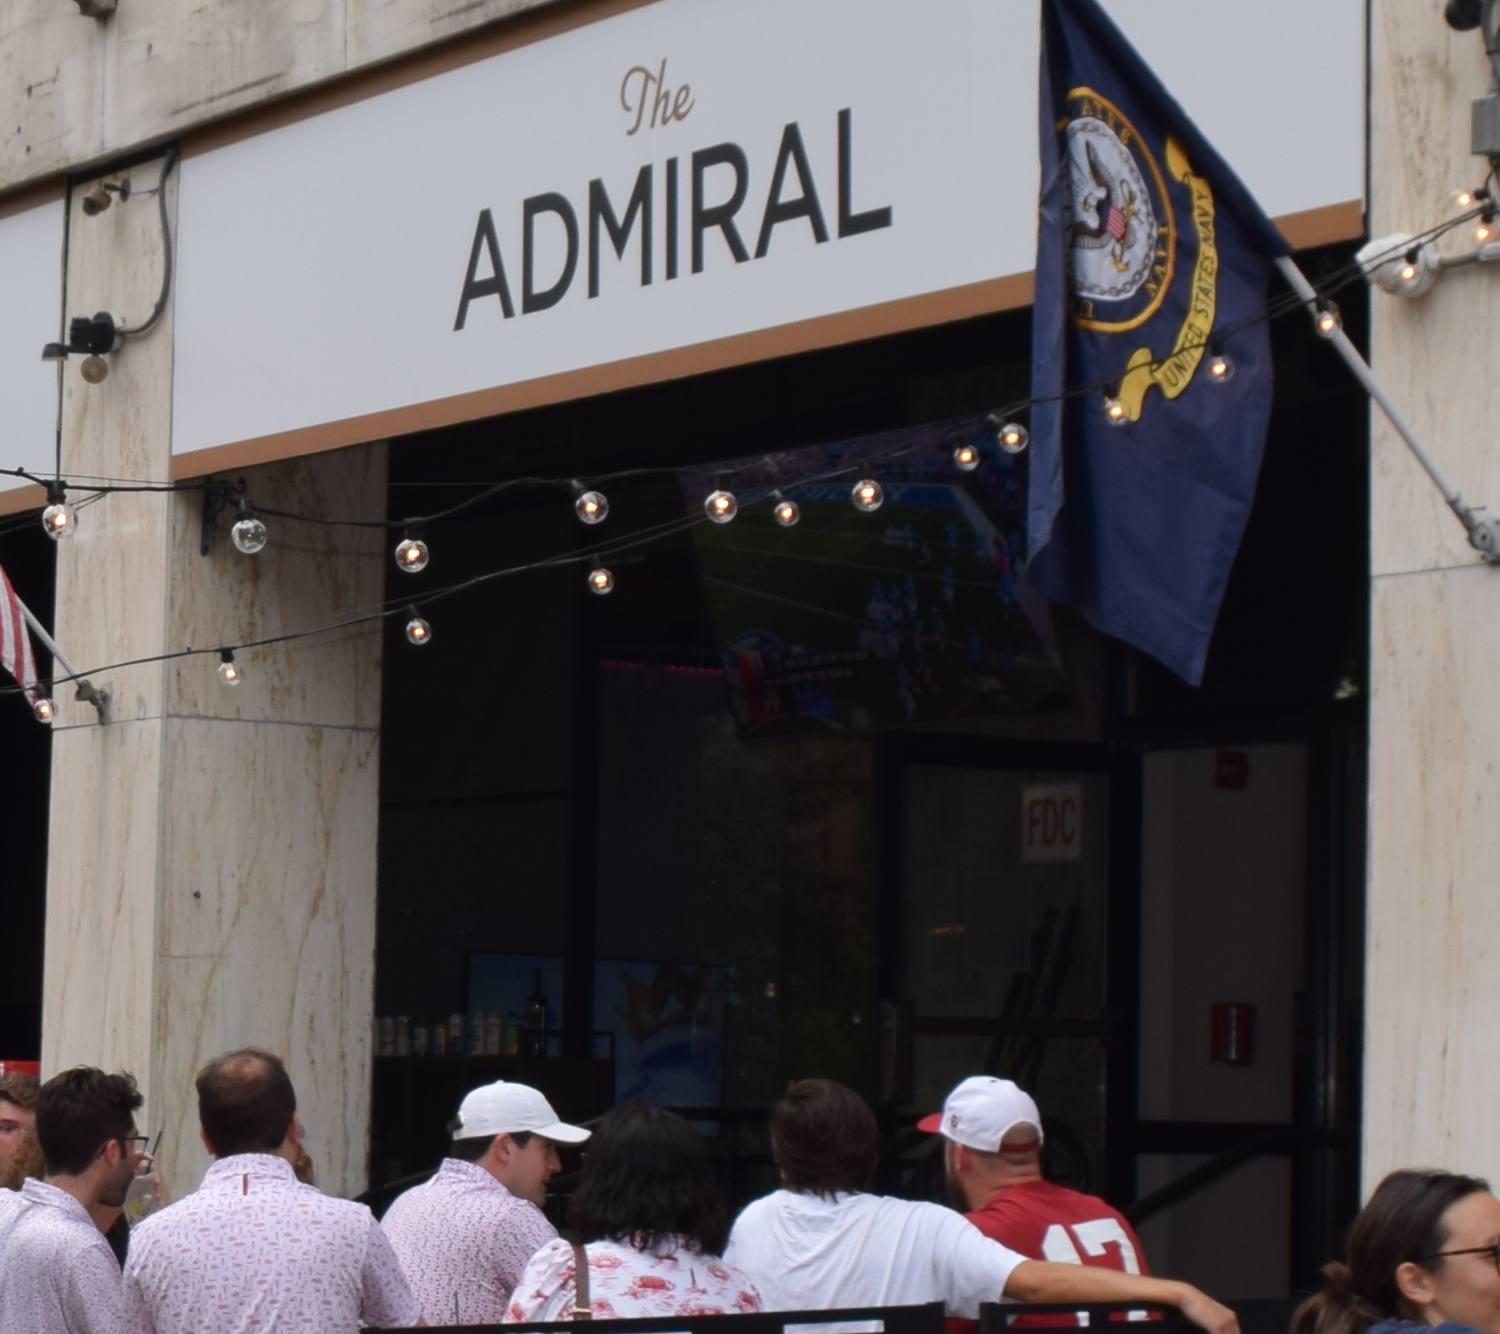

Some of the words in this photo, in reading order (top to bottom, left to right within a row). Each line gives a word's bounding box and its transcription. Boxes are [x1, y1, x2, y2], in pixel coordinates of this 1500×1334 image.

[620, 58, 696, 136] The
[452, 107, 893, 333] ADMIRAL
[1196, 191, 1214, 248] NAVY
[1193, 253, 1217, 319] STATES
[1162, 323, 1207, 389] UNITED
[1028, 797, 1075, 846] FDC
